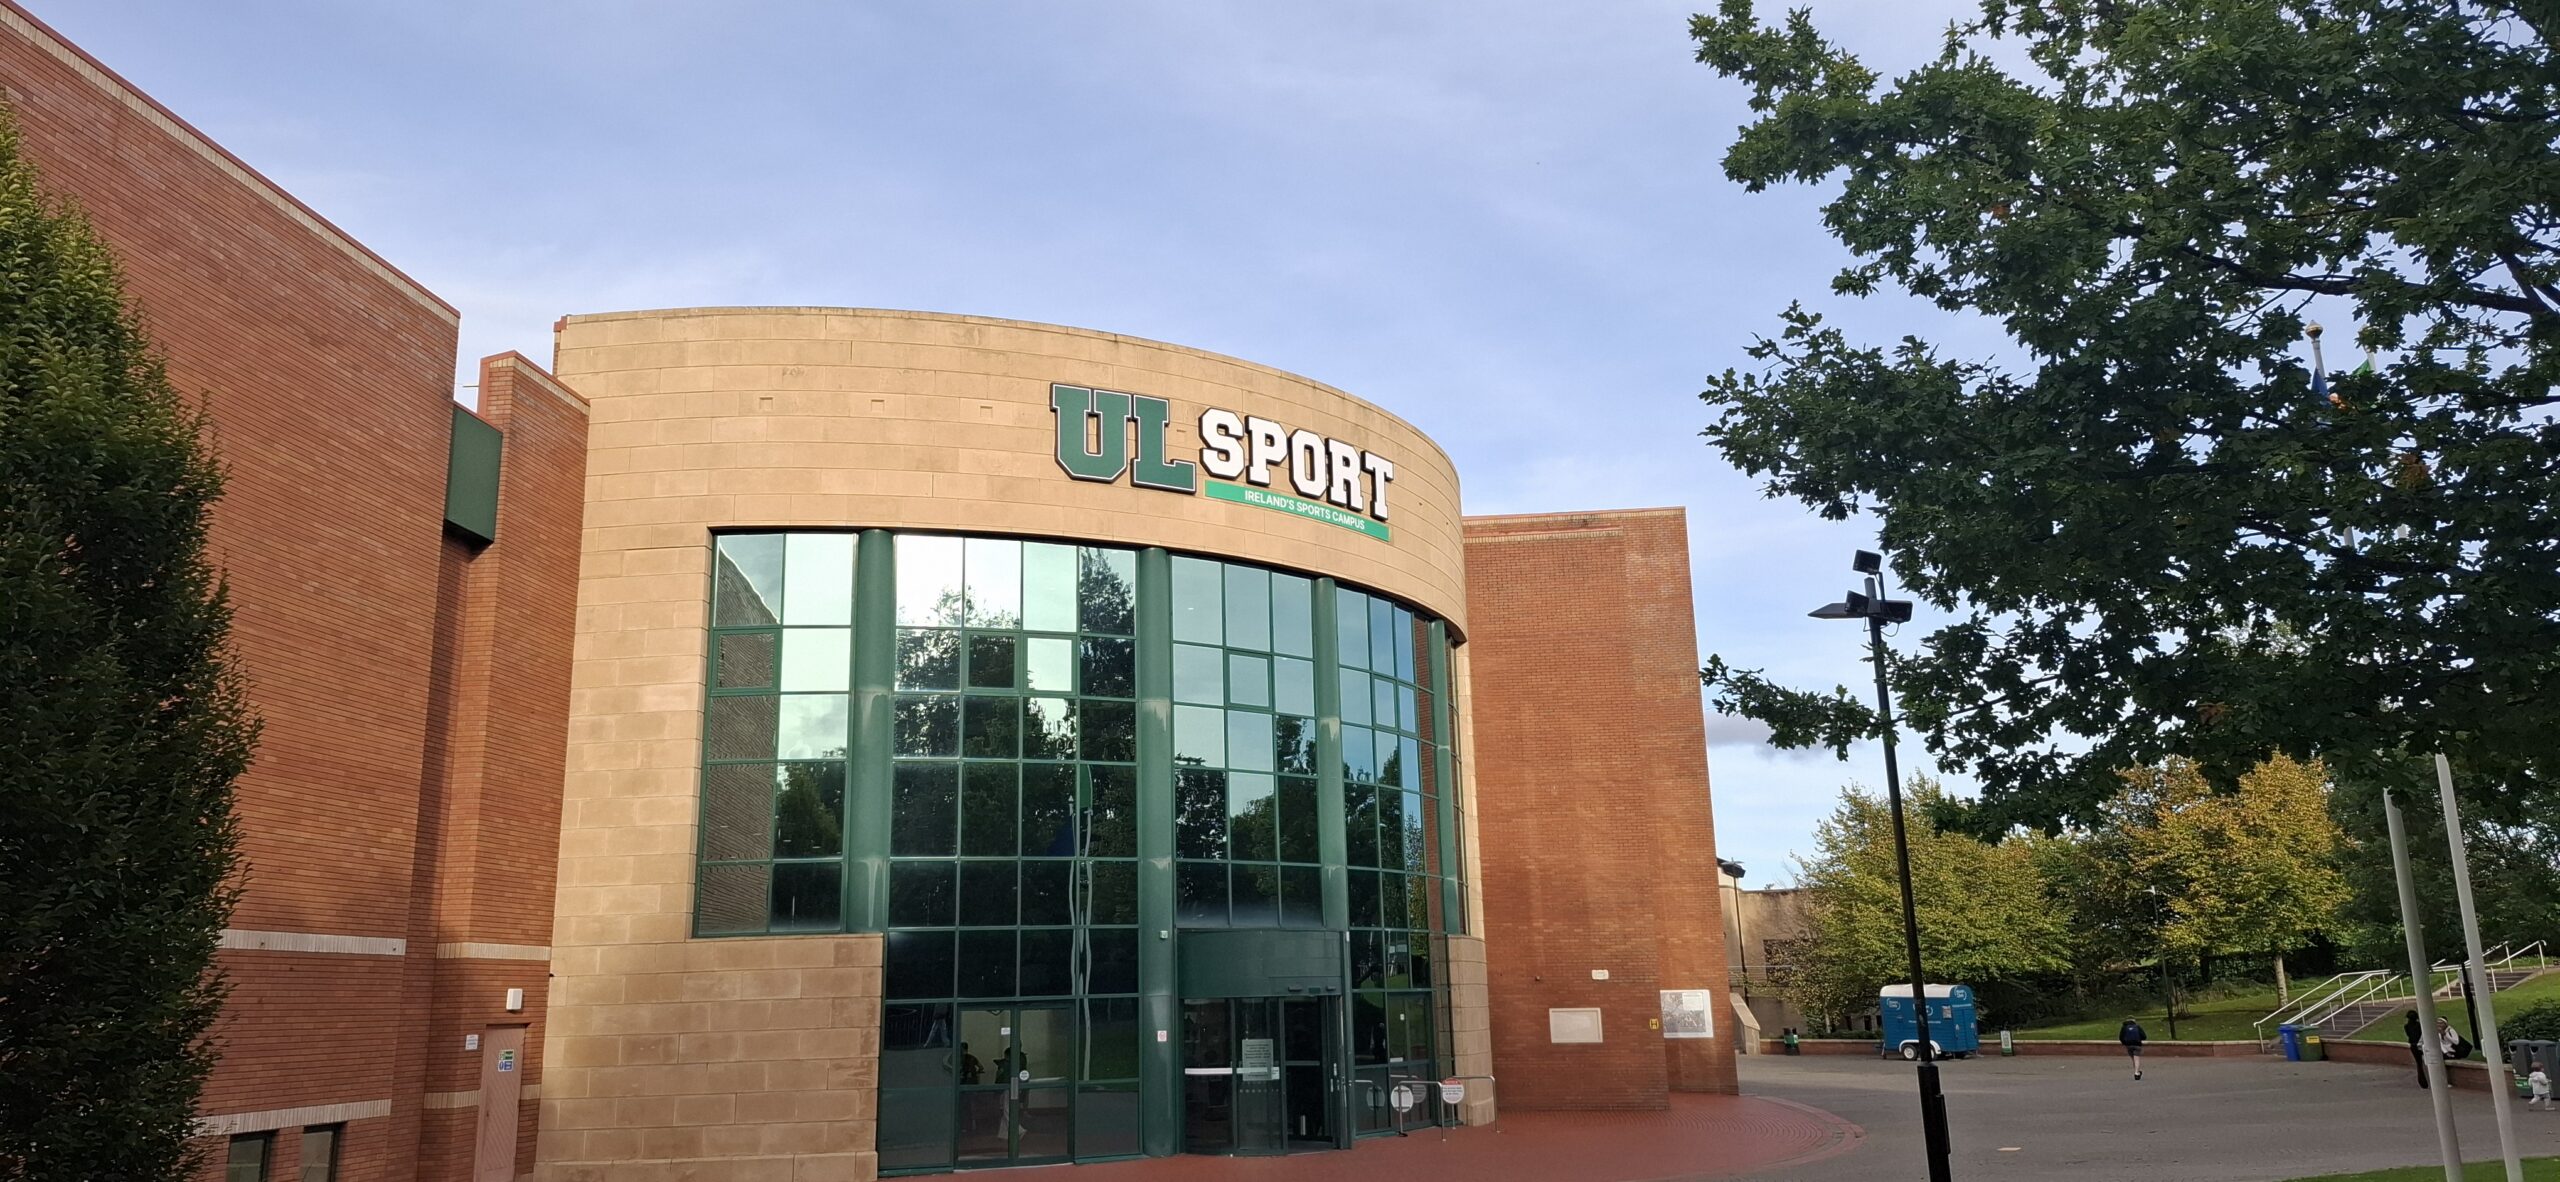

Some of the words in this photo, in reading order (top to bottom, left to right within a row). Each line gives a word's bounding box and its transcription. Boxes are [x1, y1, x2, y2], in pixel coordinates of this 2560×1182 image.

[1050, 383, 1196, 495] UL
[1199, 407, 1394, 521] SPORT
[1244, 490, 1295, 511] IRELAND'S
[1296, 501, 1331, 520] SPORTS
[1332, 511, 1366, 530] CAMPUS
